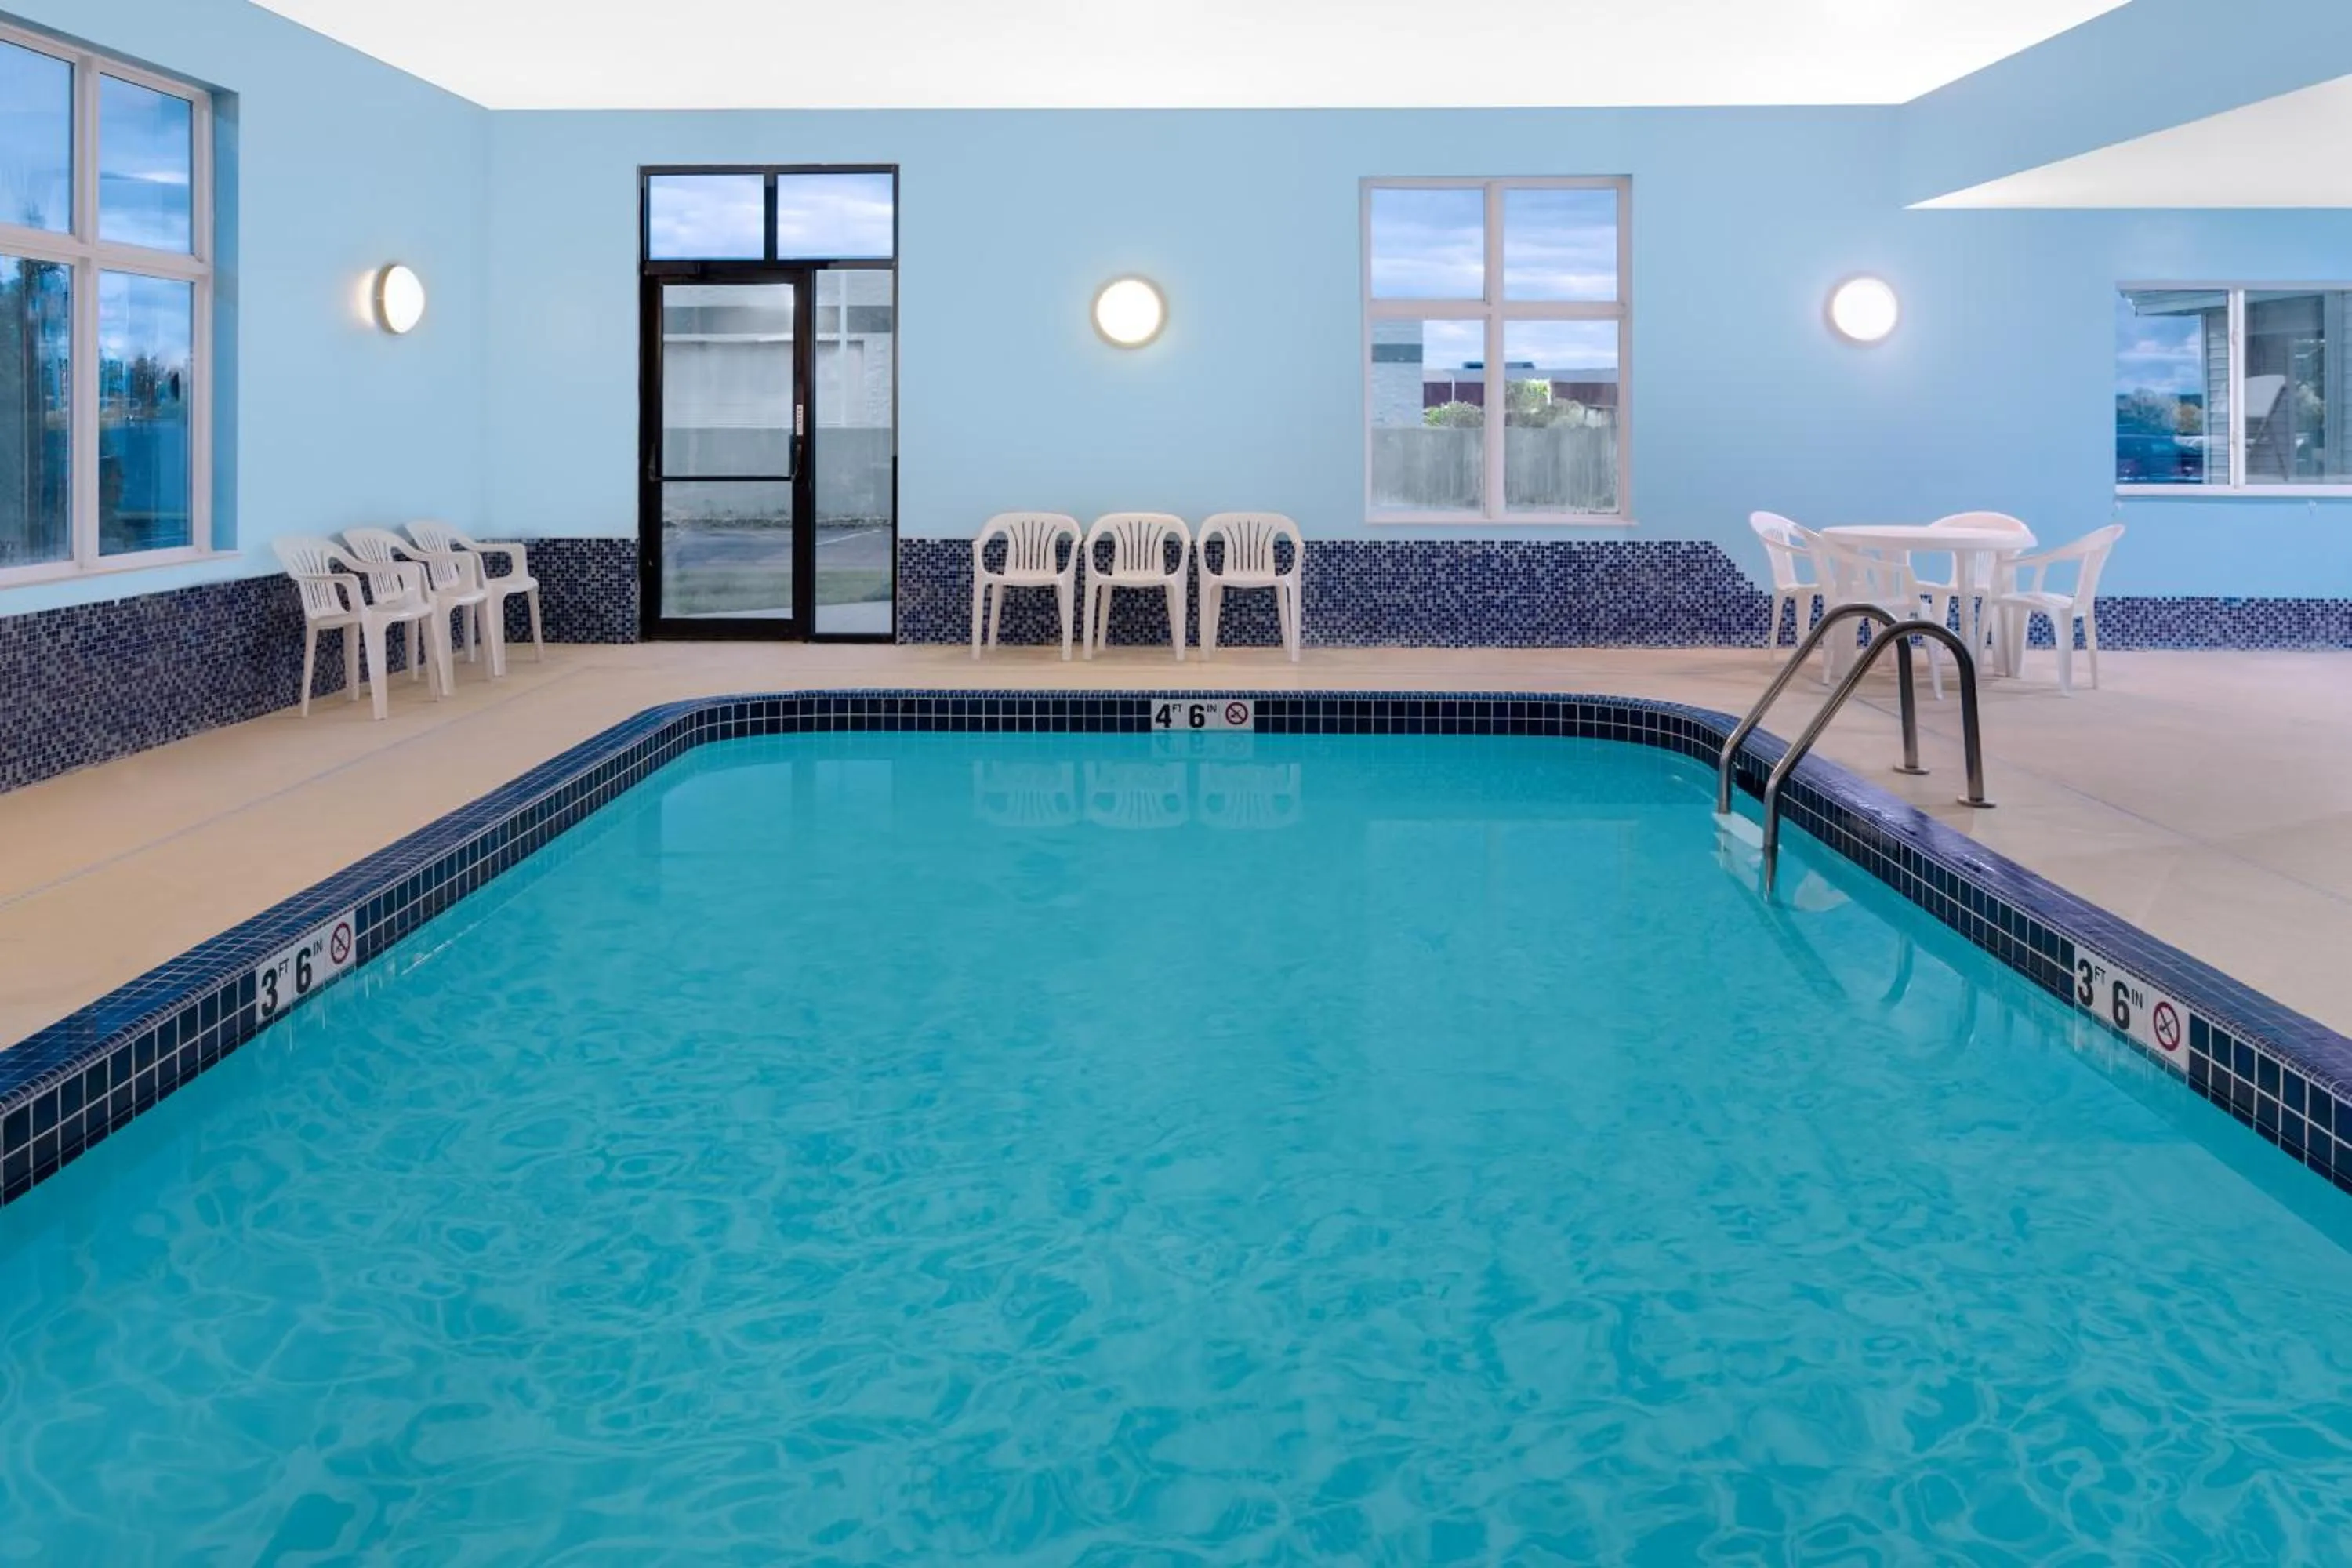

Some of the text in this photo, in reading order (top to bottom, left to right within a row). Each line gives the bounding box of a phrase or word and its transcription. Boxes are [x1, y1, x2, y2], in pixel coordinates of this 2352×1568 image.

[1156, 703, 1217, 728] 4 FT 6 IN
[261, 938, 323, 1017] 3 FT 6 IN
[2078, 958, 2143, 1030] 3 FT 6 IN
